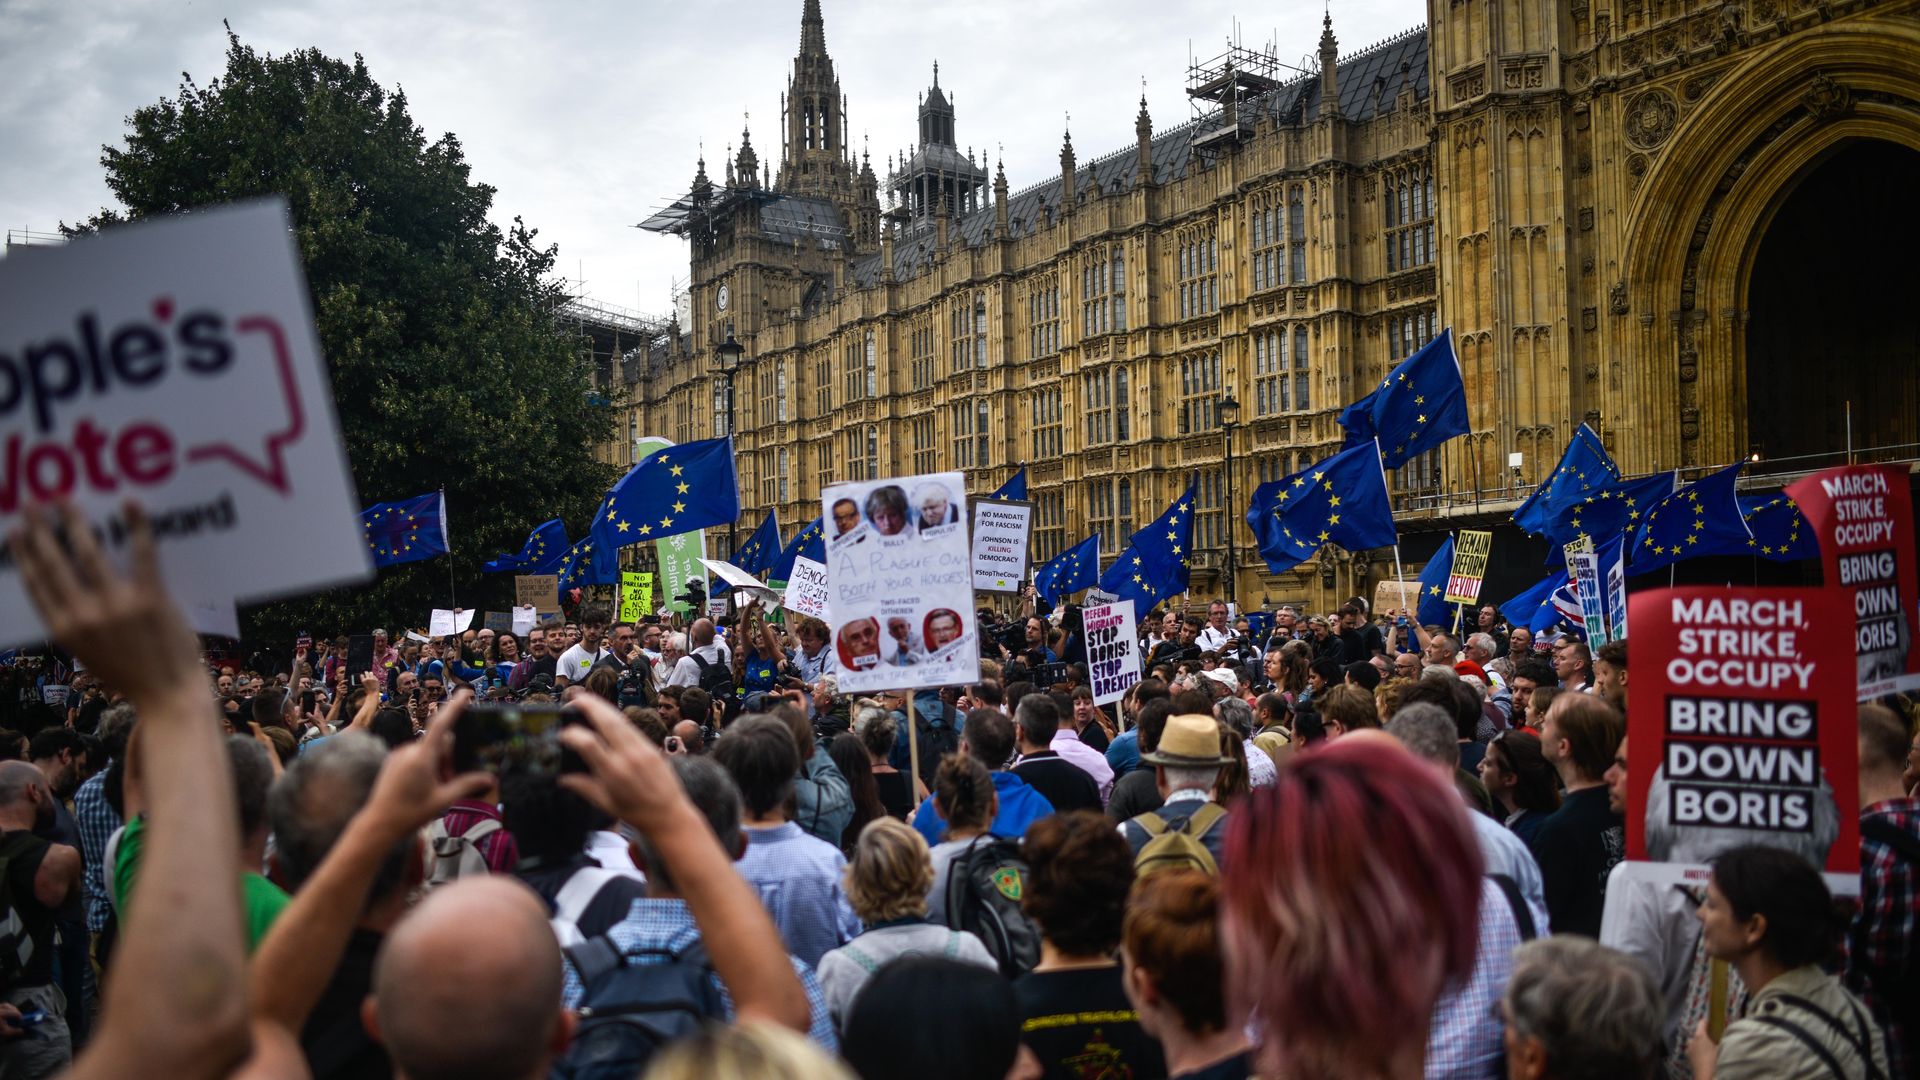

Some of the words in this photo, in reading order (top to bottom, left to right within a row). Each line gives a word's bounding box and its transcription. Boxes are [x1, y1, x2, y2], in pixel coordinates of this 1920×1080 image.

[1820, 473, 1890, 499] MARCH,
[993, 511, 1024, 521] MANDATE
[1835, 497, 1887, 521] STRIKE,
[995, 521, 1022, 530] FASCISM
[1834, 519, 1894, 547] OCCUPY
[981, 536, 1012, 544] JOHNSON
[987, 546, 1012, 554] KILLING
[1457, 532, 1490, 556] REMAIN
[1566, 538, 1586, 552] STOP
[978, 553, 1019, 563] DEMOCRACY
[1452, 553, 1488, 577] REFORM
[1839, 552, 1895, 585] BRING
[975, 569, 1019, 579] #StopTheCoup
[797, 581, 813, 594] RIP
[1447, 574, 1481, 599] REVOLT
[1084, 606, 1111, 620] DEFEND
[1855, 585, 1898, 617] OWN
[1086, 615, 1123, 633] MIGRANTS
[1671, 597, 1809, 632] MARCH,
[1088, 626, 1118, 647] STOP
[1677, 627, 1802, 661] STRIKE,
[1090, 640, 1130, 664] BORIS!
[1092, 658, 1122, 680] STOP
[1666, 657, 1816, 690] OCCUPY
[1094, 671, 1138, 698] BREXIT!
[1670, 698, 1813, 739] BRING
[1668, 742, 1814, 784] DOWN
[1675, 787, 1810, 829] BORIS
